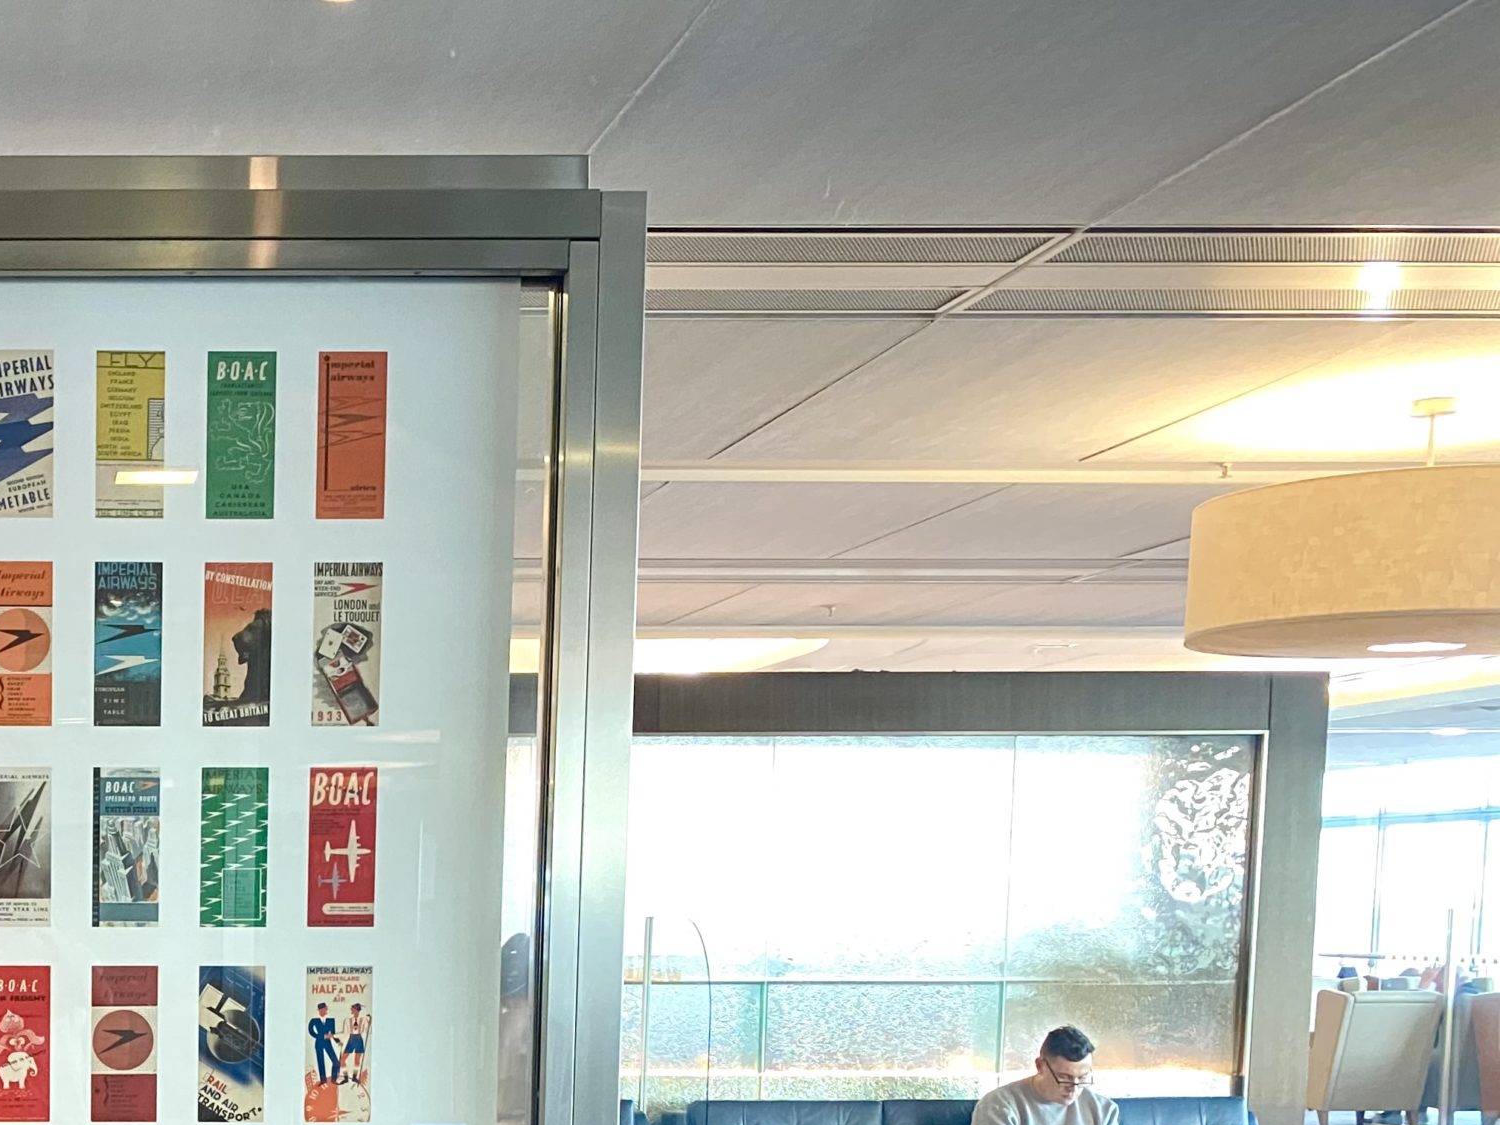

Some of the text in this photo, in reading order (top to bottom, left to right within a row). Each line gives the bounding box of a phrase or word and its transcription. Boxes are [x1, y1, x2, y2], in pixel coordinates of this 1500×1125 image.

[109, 352, 156, 367] FLY
[98, 563, 157, 576] IMPERIAL
[315, 563, 382, 577] IMPERIAL AIRWAYS
[98, 576, 157, 590] AIRWAYS
[206, 570, 271, 591] BY CONSTELLATION
[334, 600, 367, 610] LONDON
[334, 612, 380, 622] LE TOUQUET
[215, 707, 239, 721] GREAT
[241, 703, 269, 717] BRITAIN
[311, 711, 342, 722] 1933
[105, 781, 136, 793] BOAC
[312, 985, 336, 994] HALF
[345, 984, 367, 994] DAY
[206, 1075, 228, 1095] RAIL
[201, 1085, 239, 1112] AND AIR
